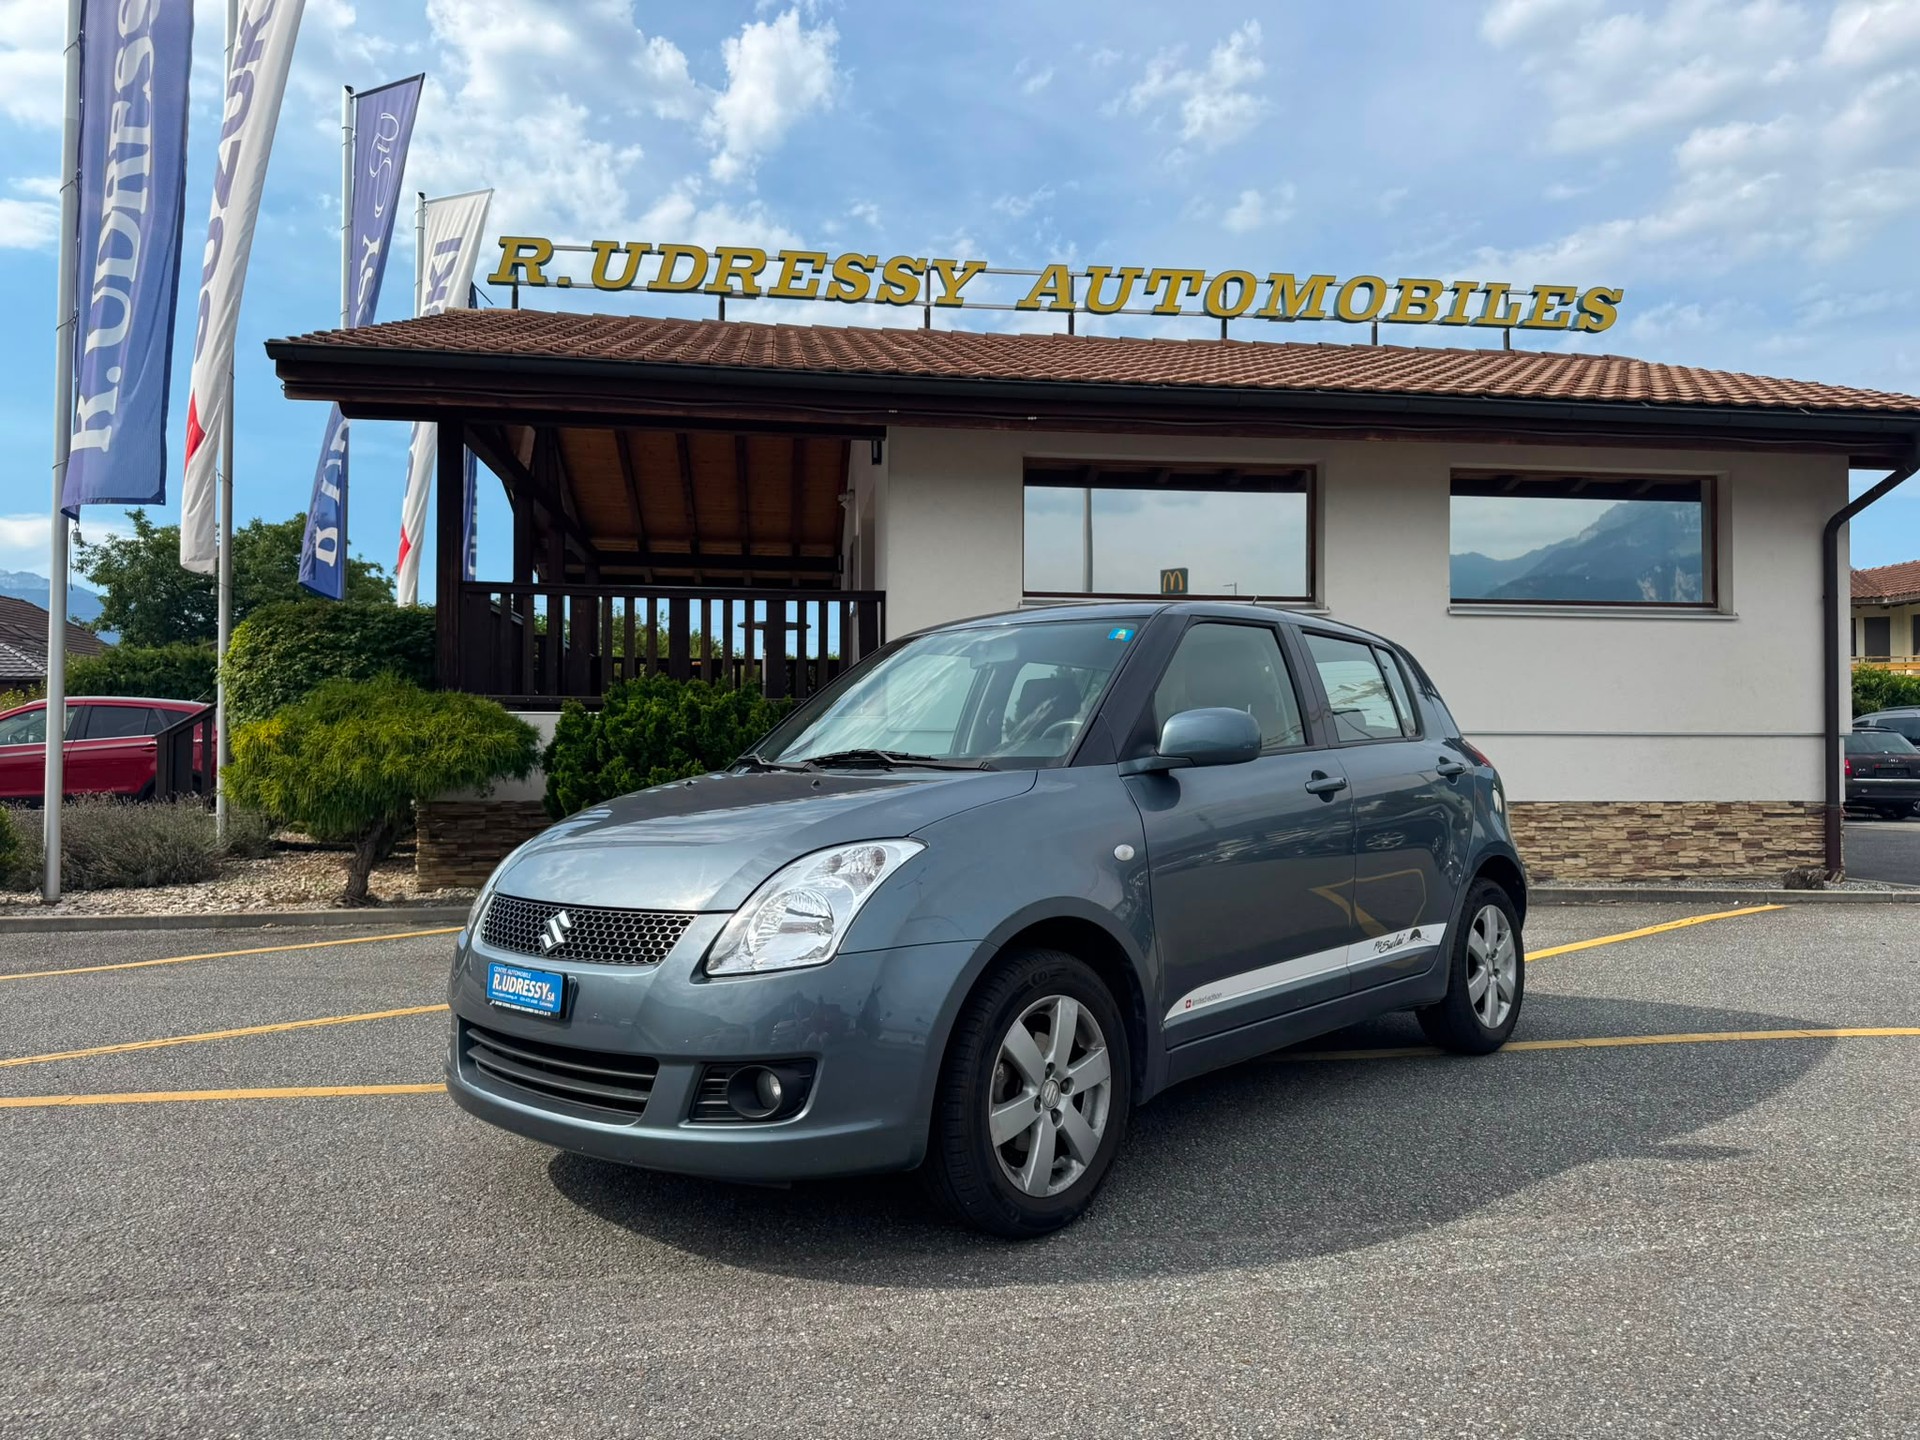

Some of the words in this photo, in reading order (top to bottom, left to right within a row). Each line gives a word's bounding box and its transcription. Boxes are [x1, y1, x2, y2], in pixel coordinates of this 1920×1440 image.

[487, 235, 987, 307] R.UDRESSY
[1016, 264, 1624, 333] AUTOMOBILES
[492, 973, 550, 1000] R.UDRESSY
